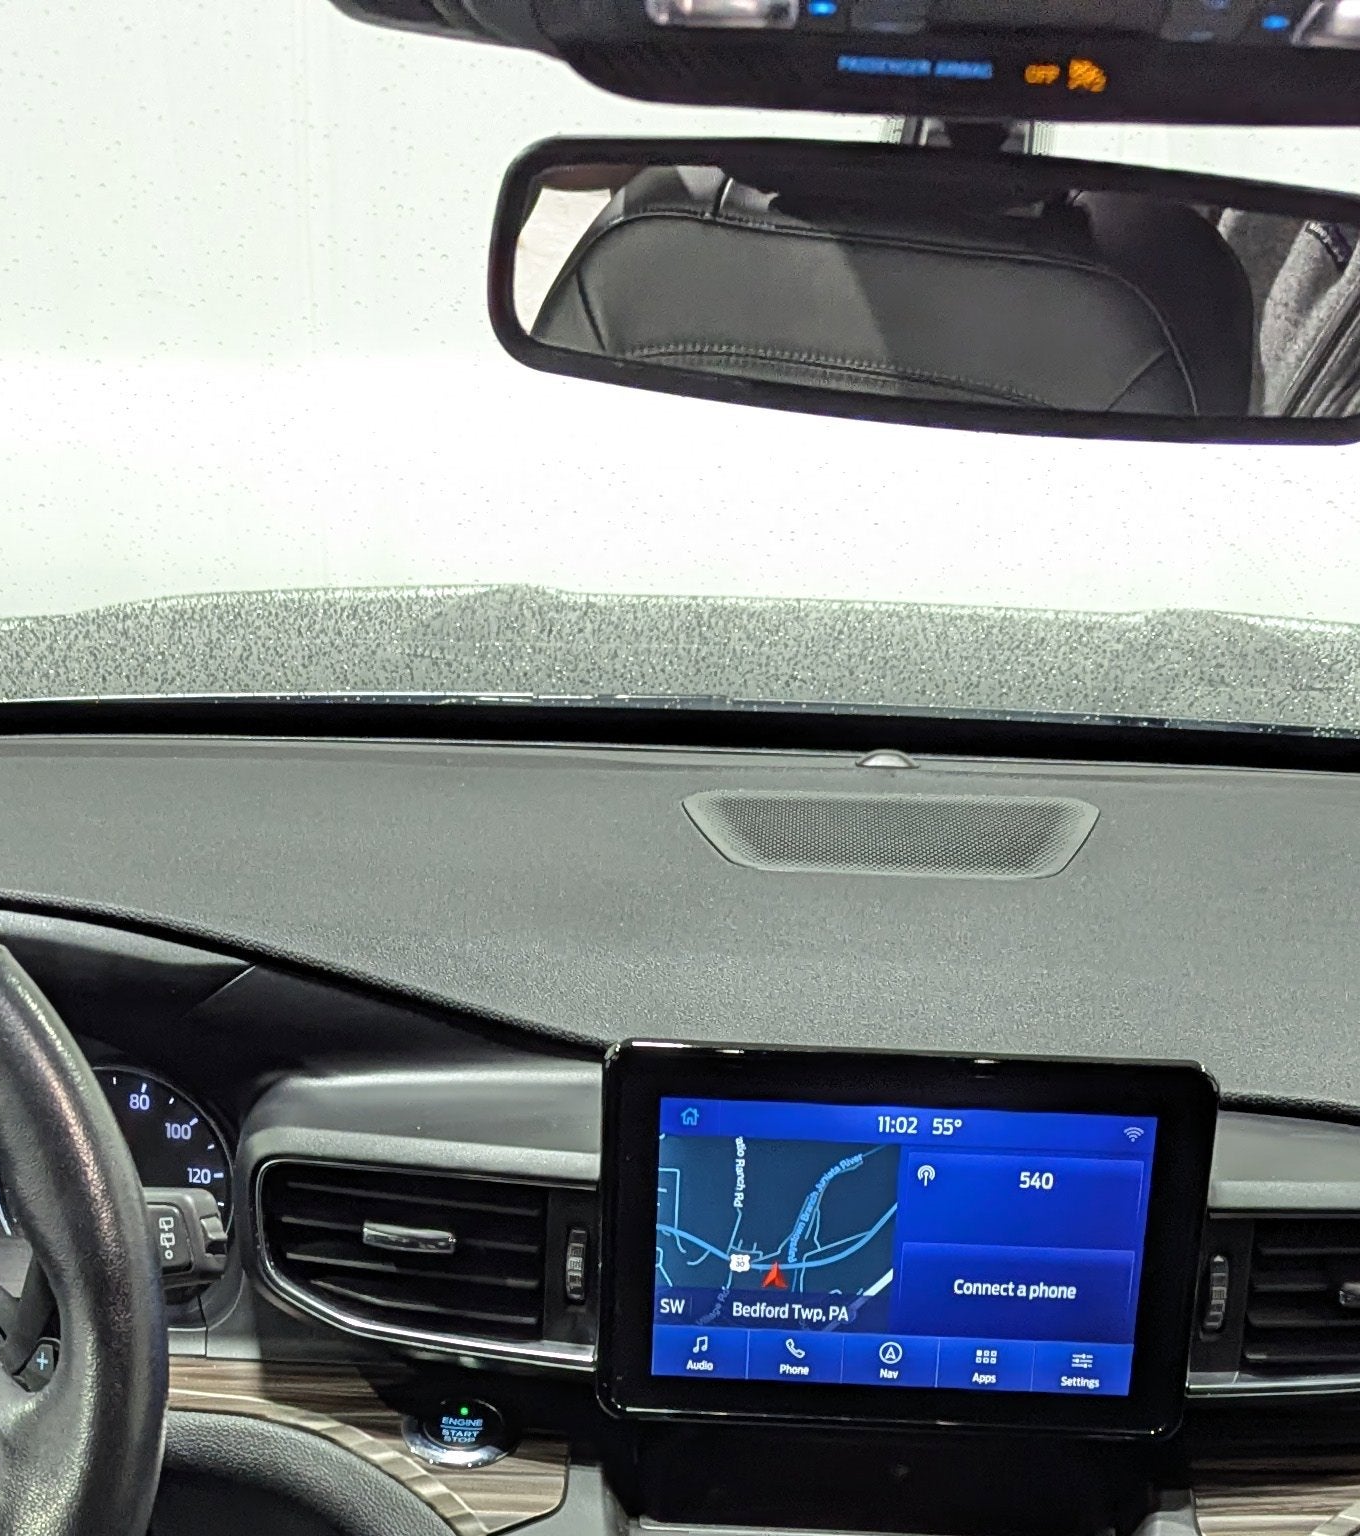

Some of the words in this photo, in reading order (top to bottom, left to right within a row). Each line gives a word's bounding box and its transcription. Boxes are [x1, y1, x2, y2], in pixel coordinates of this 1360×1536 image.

[129, 1093, 150, 1111] 80
[165, 1122, 192, 1140] 100
[877, 1116, 918, 1134] 11:02
[932, 1117, 963, 1136] 55°
[839, 1153, 863, 1170] River
[187, 1167, 211, 1185] 120
[735, 1159, 746, 1191] Ranch
[1019, 1171, 1054, 1190] 540
[733, 1192, 745, 1208] Rd
[953, 1278, 1015, 1297] Connect
[1016, 1284, 1027, 1297] a
[1029, 1281, 1077, 1300] phone
[660, 1298, 685, 1315] SW
[732, 1301, 789, 1319] Bedford
[792, 1304, 826, 1322] Twp,
[829, 1306, 849, 1322] PA
[686, 1359, 714, 1372] Audio
[779, 1363, 810, 1376] Phone
[879, 1368, 899, 1380] Nav
[972, 1372, 997, 1385] Apps
[1060, 1375, 1100, 1389] Settings
[441, 1416, 484, 1428] ENGINE
[441, 1428, 480, 1438] START
